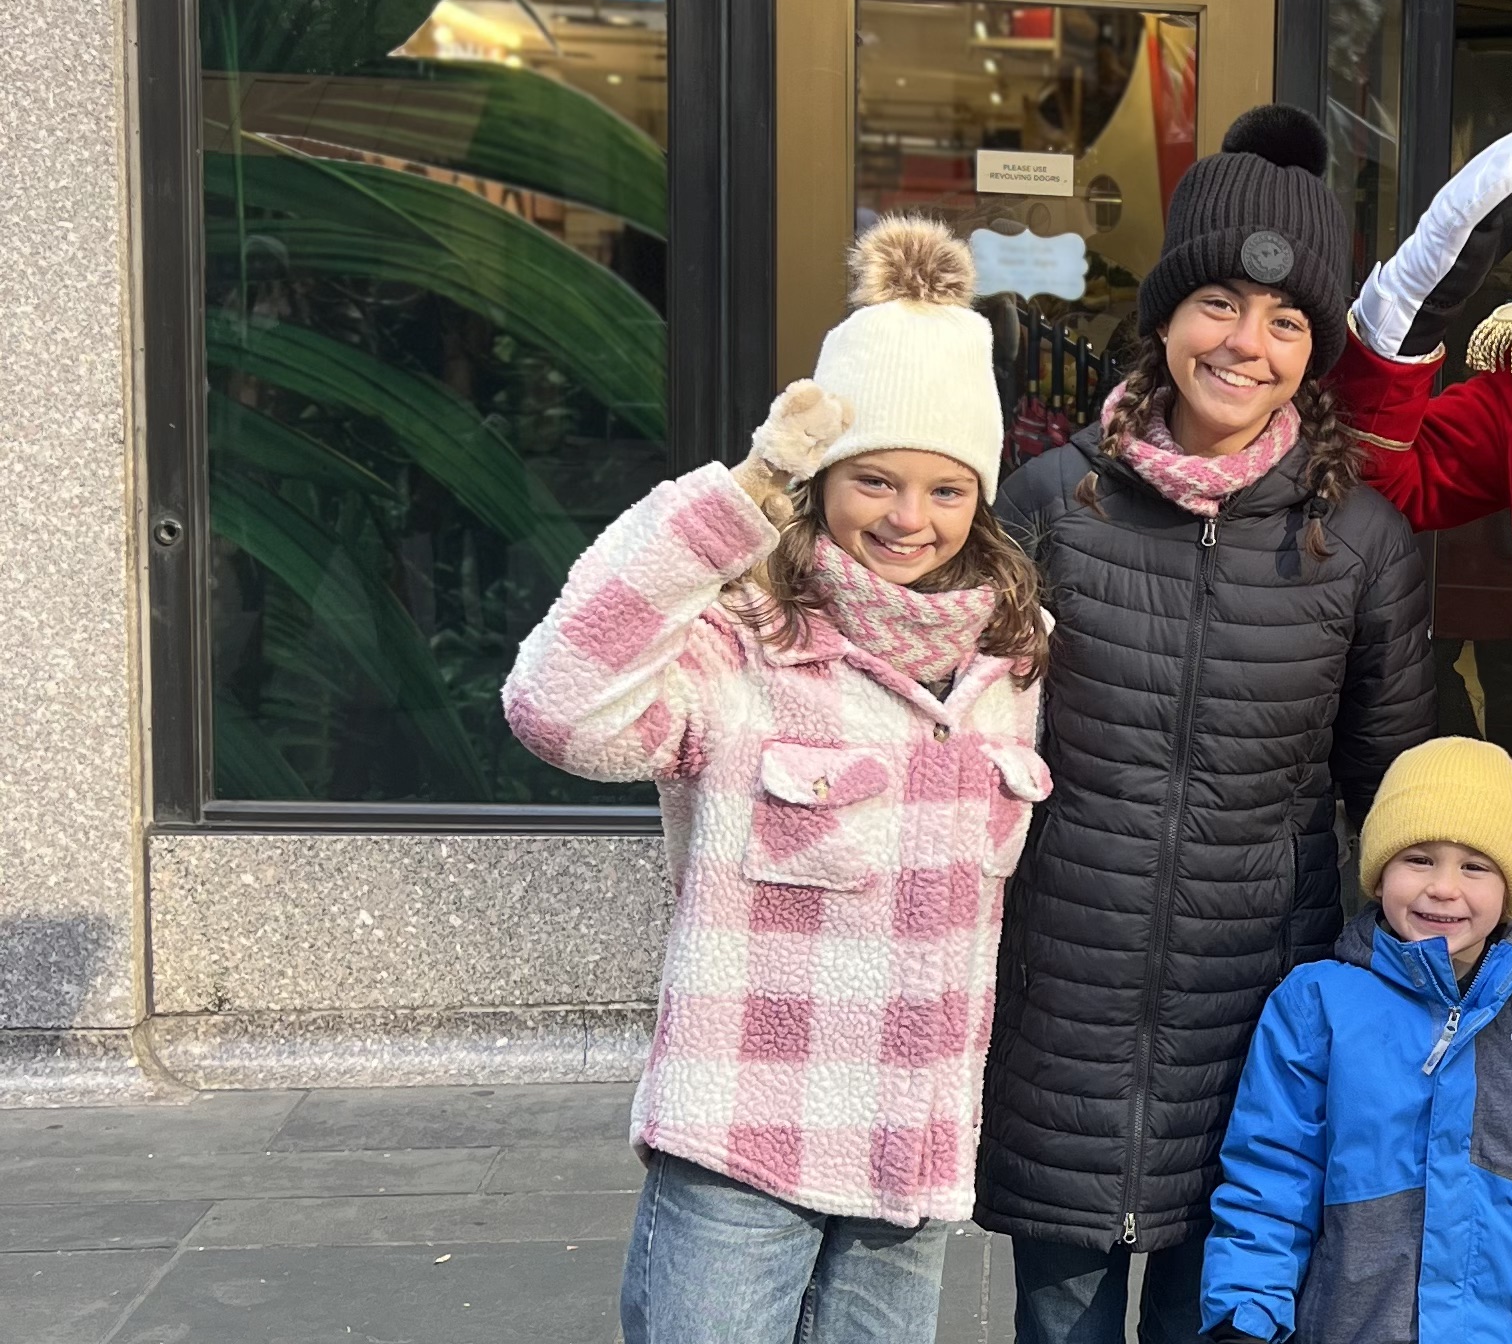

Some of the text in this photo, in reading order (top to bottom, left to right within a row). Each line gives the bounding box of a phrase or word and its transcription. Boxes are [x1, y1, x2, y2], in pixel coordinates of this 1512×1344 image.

[1003, 164, 1031, 173] PLEASE
[989, 172, 1060, 183] REVOLVING DOORS
